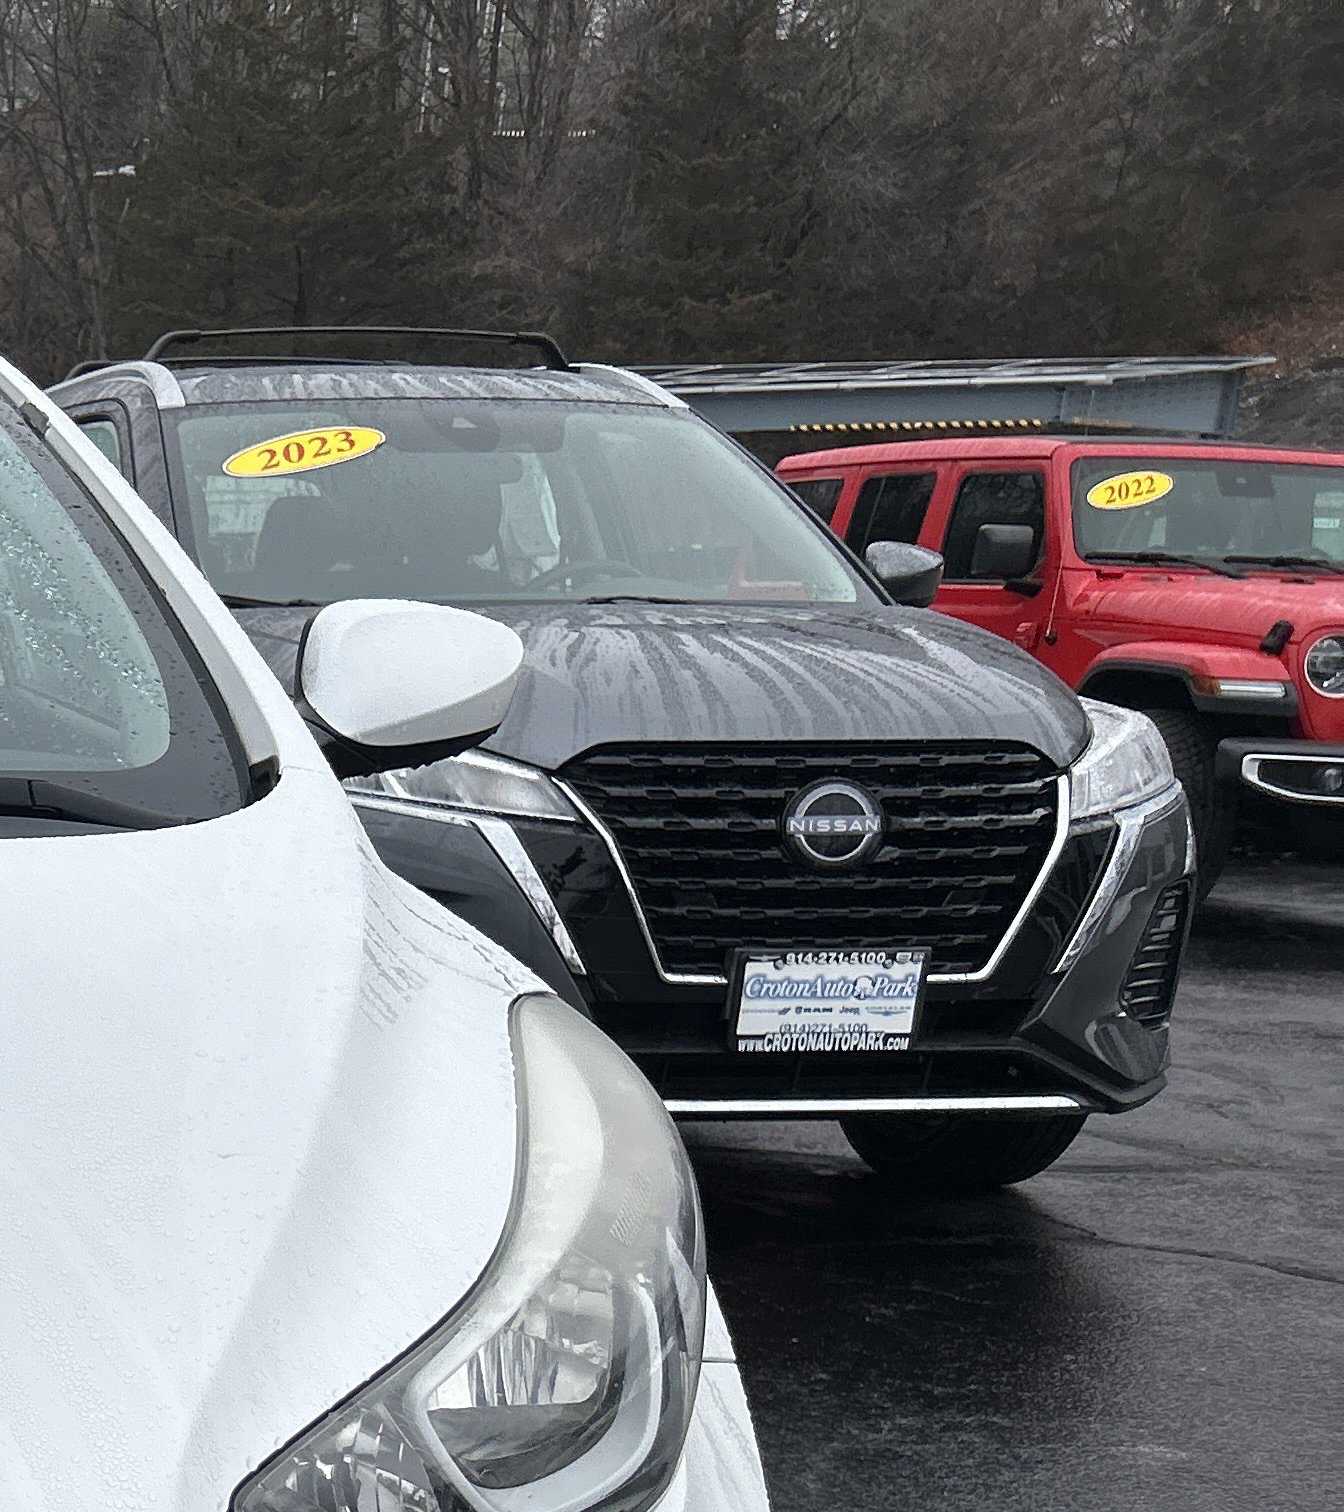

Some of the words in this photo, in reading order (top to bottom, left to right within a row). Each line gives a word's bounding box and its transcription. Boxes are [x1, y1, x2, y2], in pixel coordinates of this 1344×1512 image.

[257, 431, 356, 471] 2023
[1103, 475, 1156, 505] 2022
[789, 819, 879, 833] NISSAN
[745, 976, 854, 999] CrotonAuto
[871, 976, 917, 999] Park
